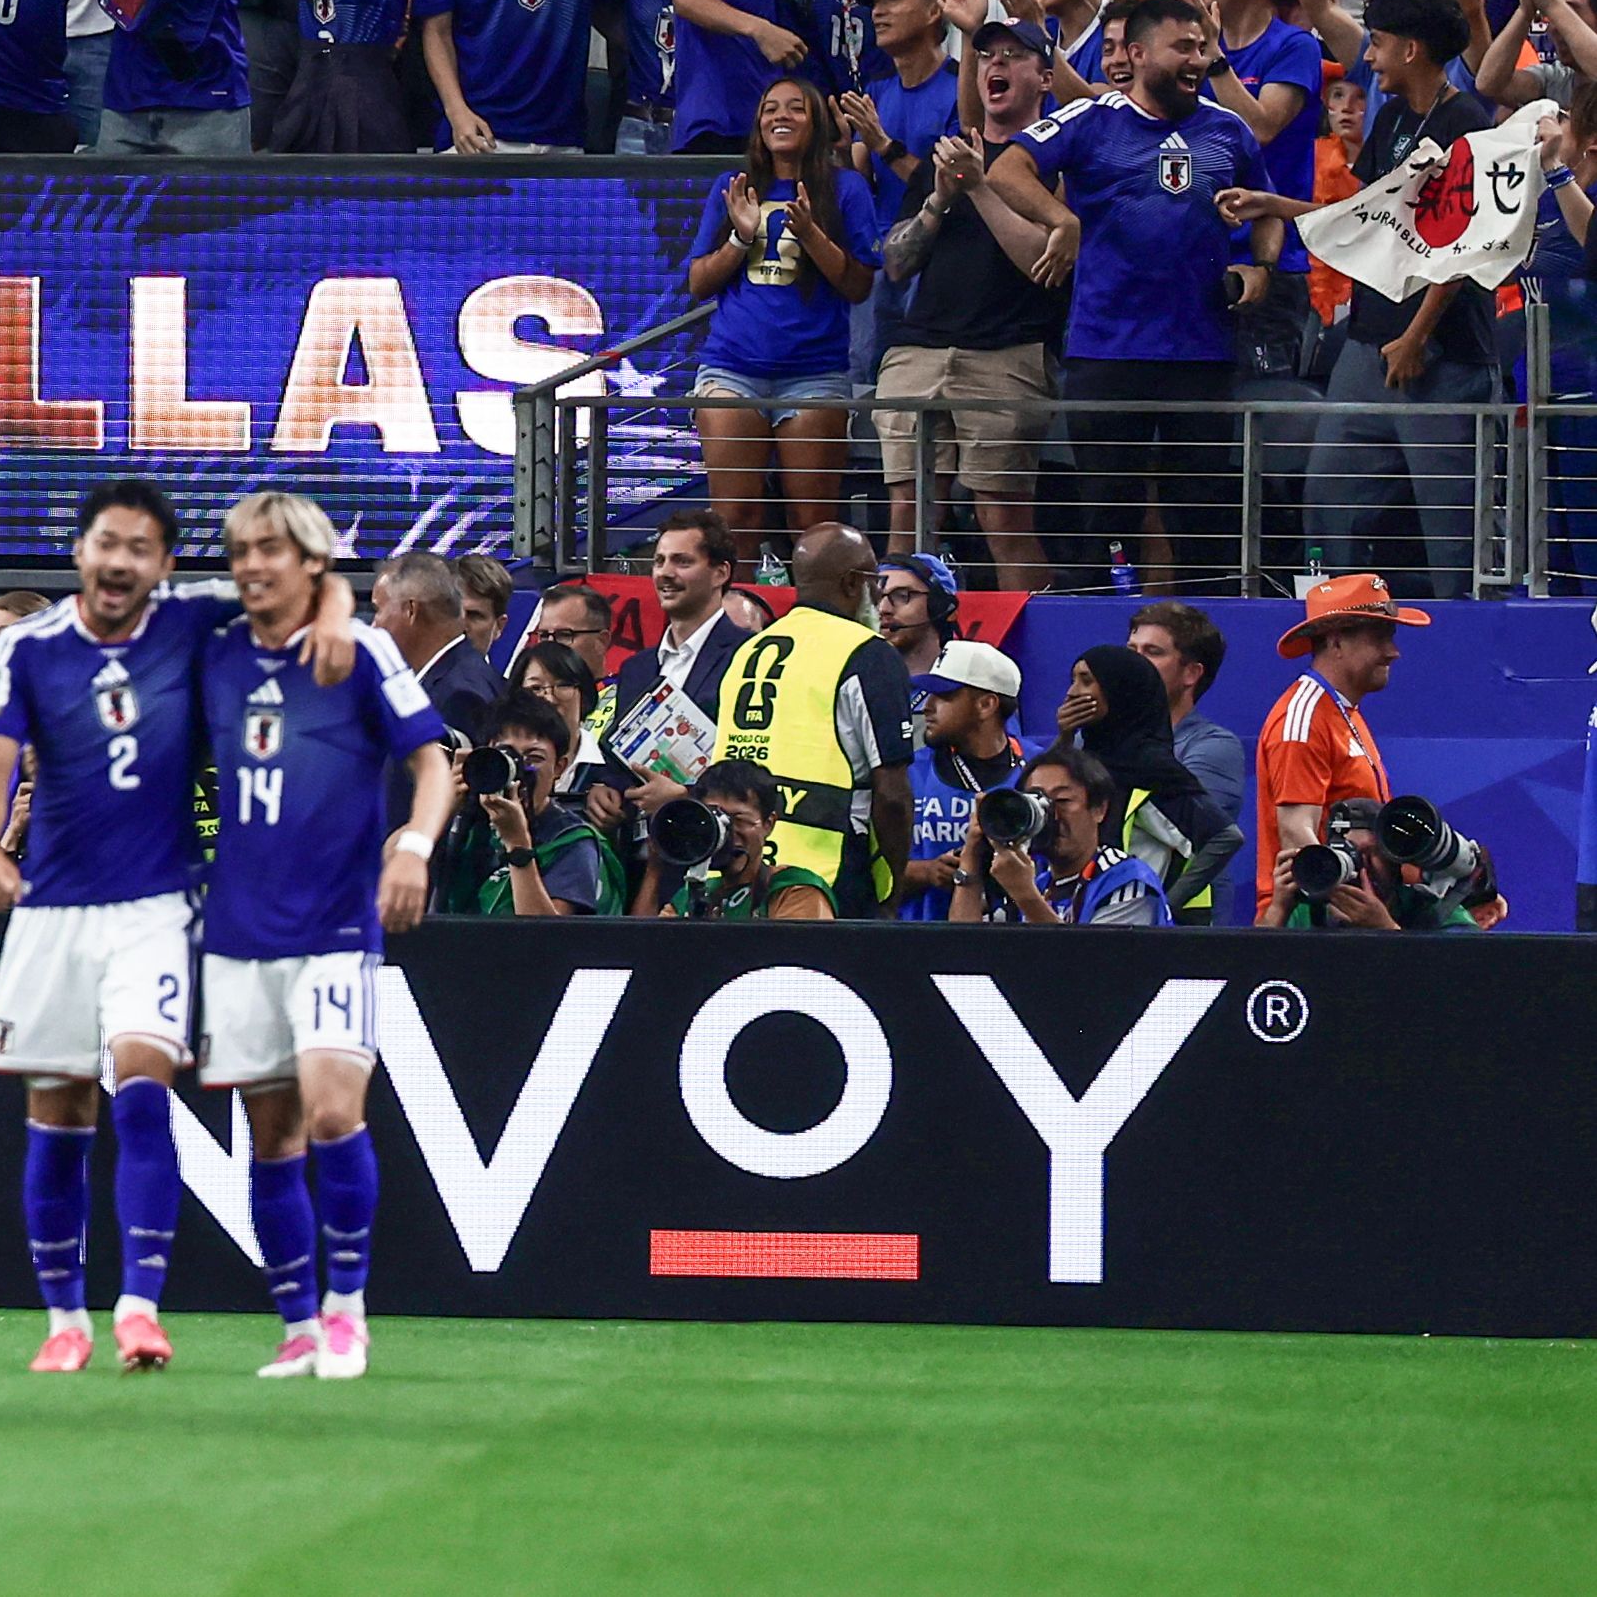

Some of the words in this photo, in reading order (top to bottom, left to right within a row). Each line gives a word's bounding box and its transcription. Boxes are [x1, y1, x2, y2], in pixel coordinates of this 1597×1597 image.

[759, 264, 783, 277] FIFA
[108, 733, 142, 791] 2
[725, 744, 769, 761] 2026
[236, 766, 285, 826] 14
[158, 973, 180, 1023] 2
[311, 985, 352, 1032] 14
